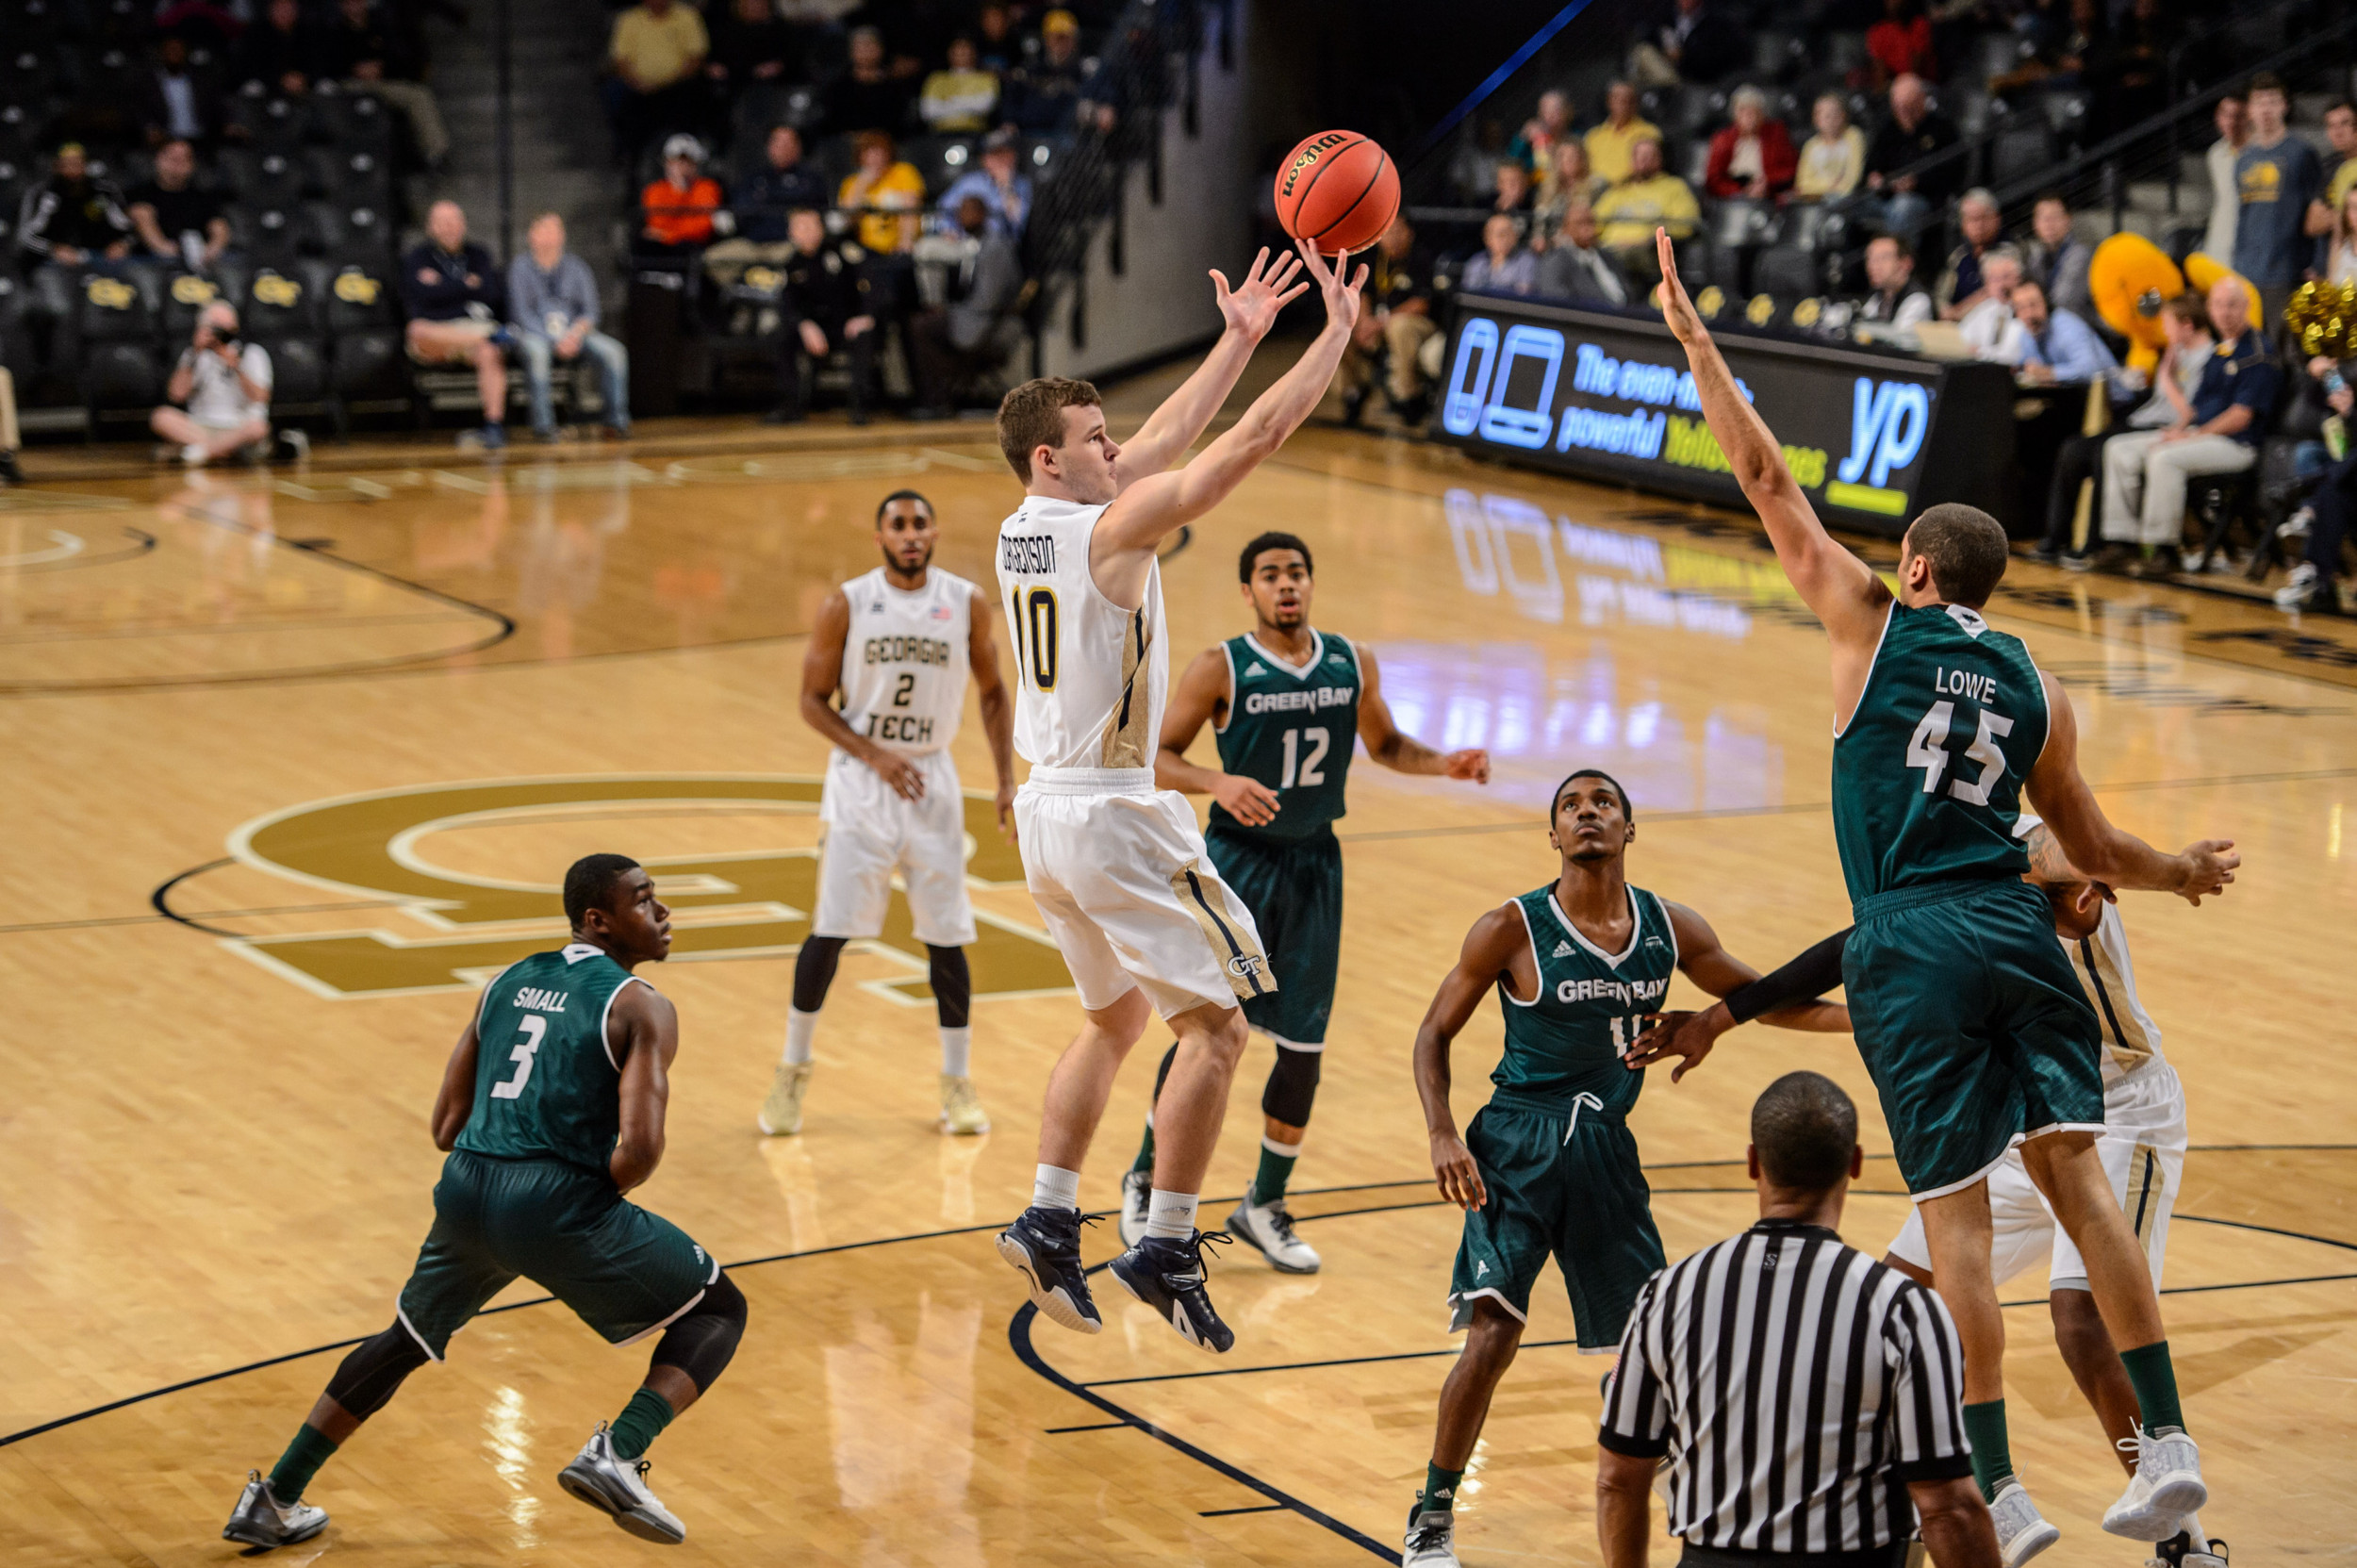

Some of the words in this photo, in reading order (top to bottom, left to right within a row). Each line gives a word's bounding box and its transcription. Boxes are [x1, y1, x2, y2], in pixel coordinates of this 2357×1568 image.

[1282, 133, 1348, 197] Wilson
[1574, 343, 1620, 397] The
[1616, 359, 1755, 412] even-m
[1556, 405, 1667, 460] powerful
[1838, 376, 1929, 488] yp
[865, 635, 950, 668] GEORGIA
[1012, 585, 1060, 693] 10
[894, 674, 915, 707] 2
[1935, 666, 1997, 703] LOWE
[868, 713, 934, 743] TECH
[1280, 726, 1330, 789] 12
[1905, 700, 2015, 807] 45
[513, 986, 569, 1013] SMALL
[489, 1014, 547, 1099] 3
